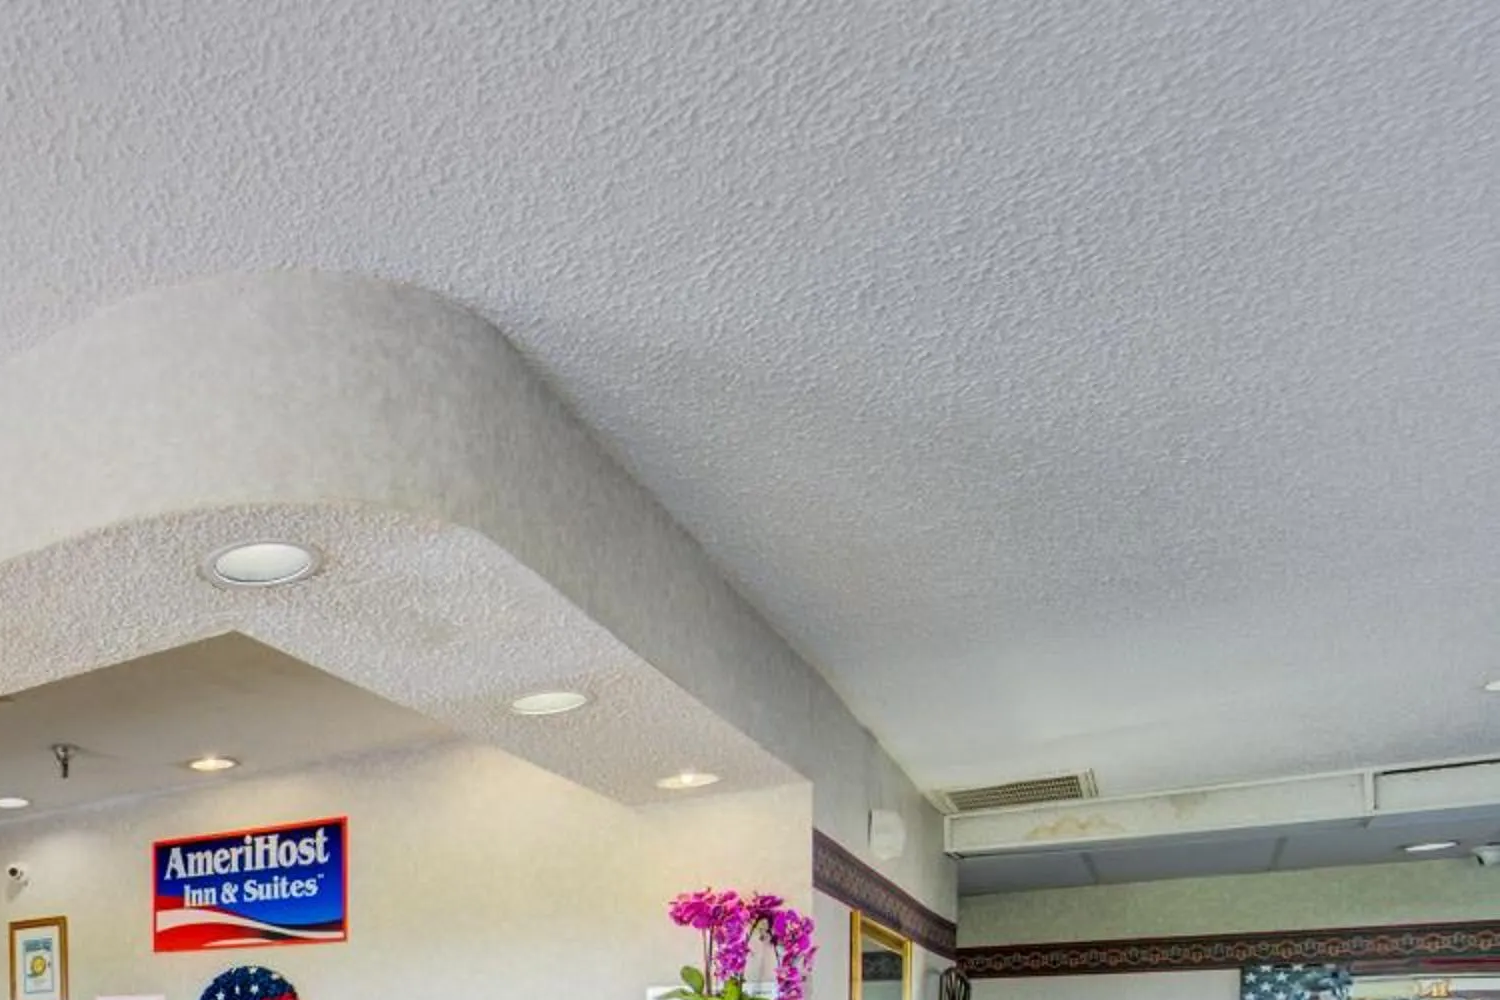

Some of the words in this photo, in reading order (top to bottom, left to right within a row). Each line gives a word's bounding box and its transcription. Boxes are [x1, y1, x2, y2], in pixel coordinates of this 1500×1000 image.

[164, 827, 329, 880] AmeriHost
[183, 884, 217, 908] Inn
[220, 882, 239, 905] &
[243, 875, 319, 902] Suites
